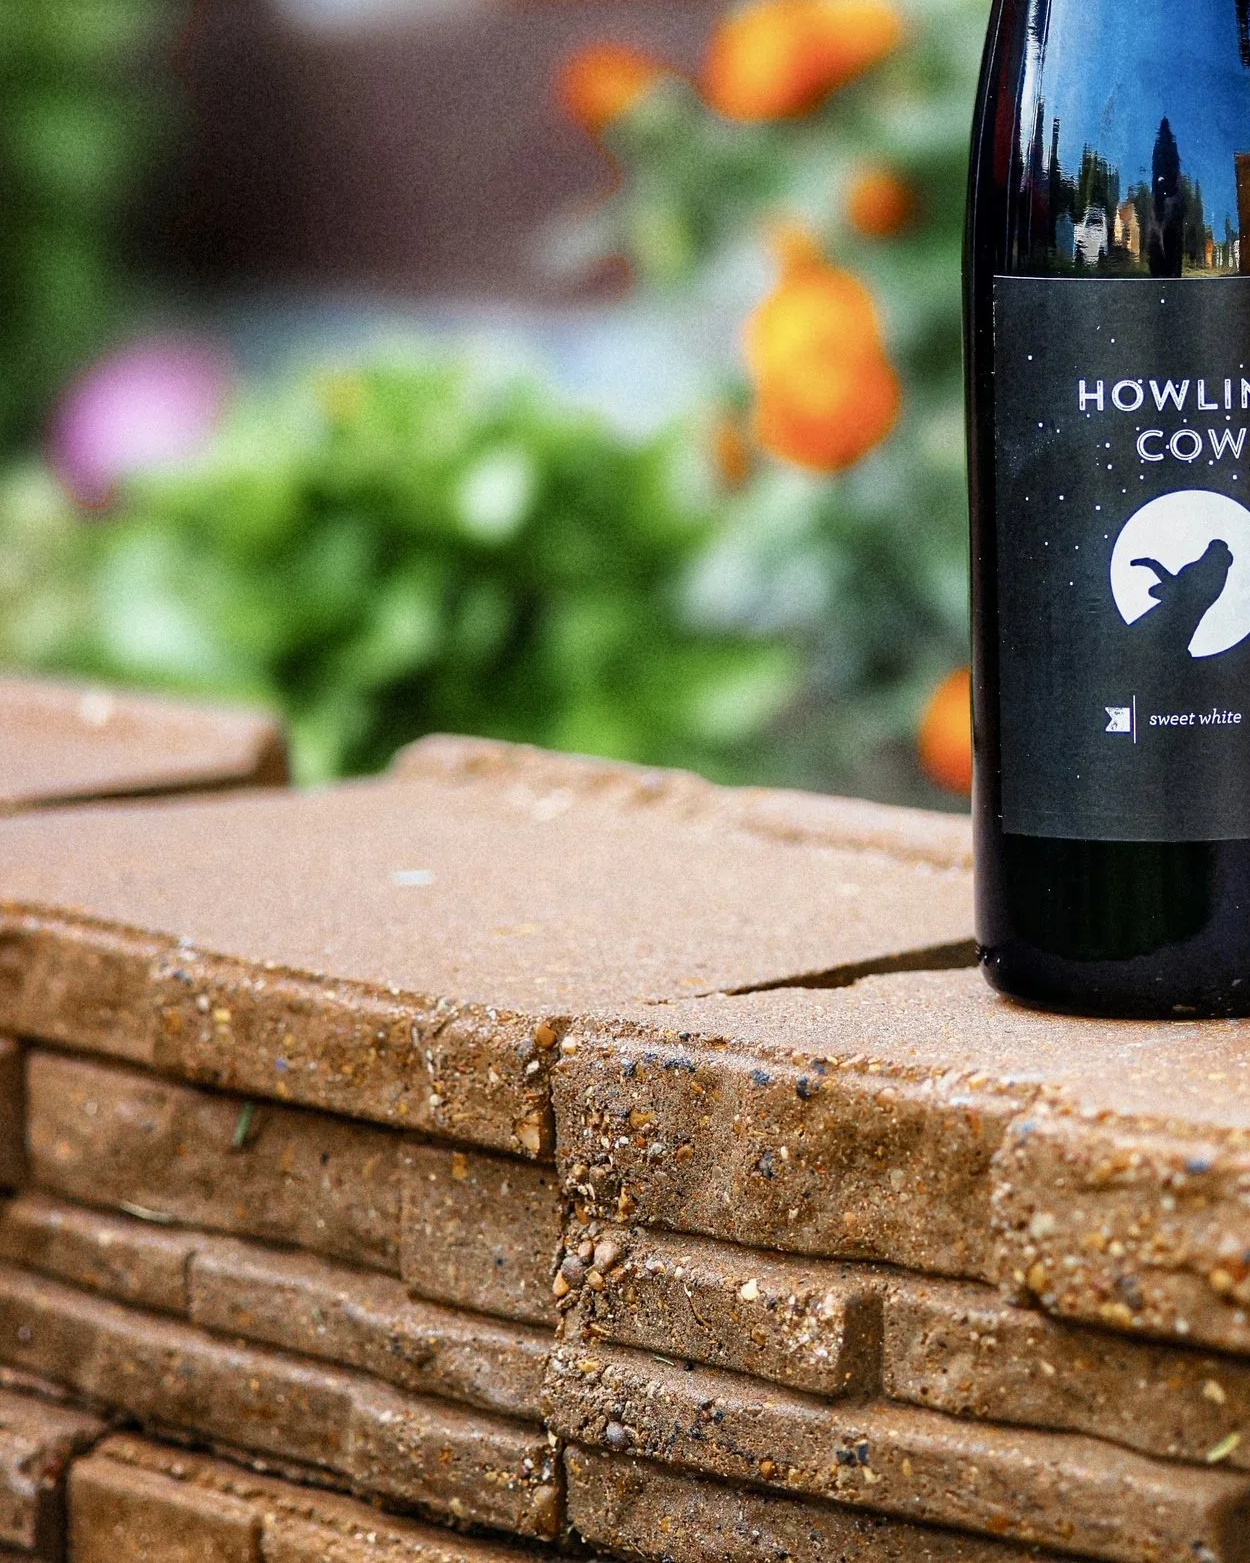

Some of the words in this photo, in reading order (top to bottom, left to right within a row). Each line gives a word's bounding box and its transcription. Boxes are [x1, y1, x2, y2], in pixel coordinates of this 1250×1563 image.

[1136, 427, 1247, 462] COW
[1149, 711, 1195, 726] sweet
[1199, 707, 1242, 725] white
